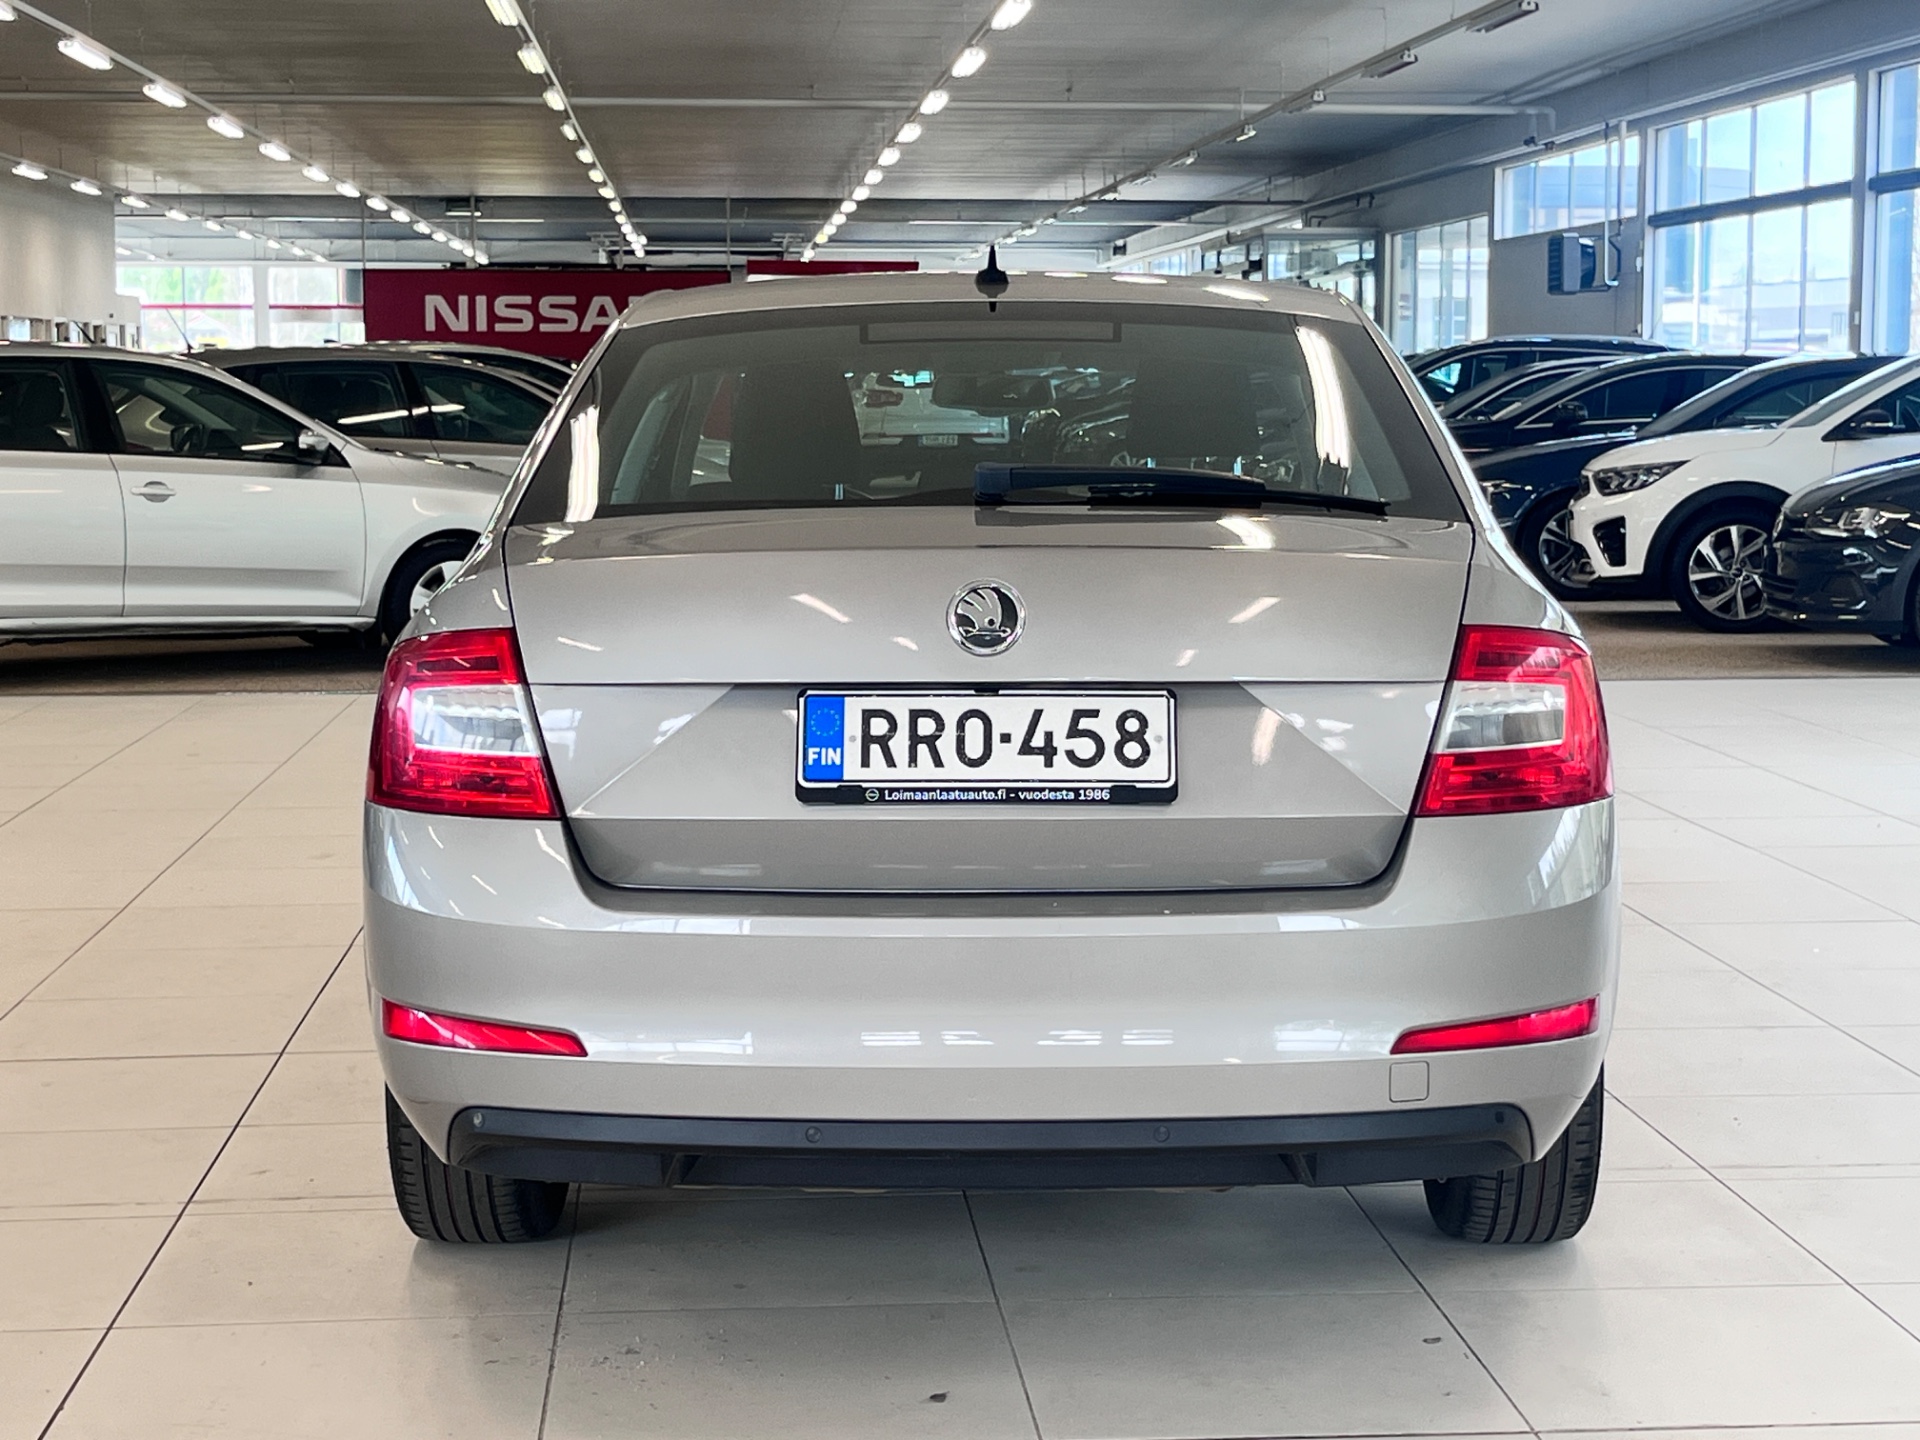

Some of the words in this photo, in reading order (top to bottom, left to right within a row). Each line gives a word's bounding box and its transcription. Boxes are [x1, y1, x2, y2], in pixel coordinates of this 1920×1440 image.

[425, 294, 643, 333] NISSA
[860, 708, 1151, 769] RRO-458
[808, 747, 842, 766] FIN
[884, 789, 1006, 801] Loimaanlaatuauto.fi
[1018, 789, 1075, 801] vuodesta
[1078, 789, 1111, 801] 1986
